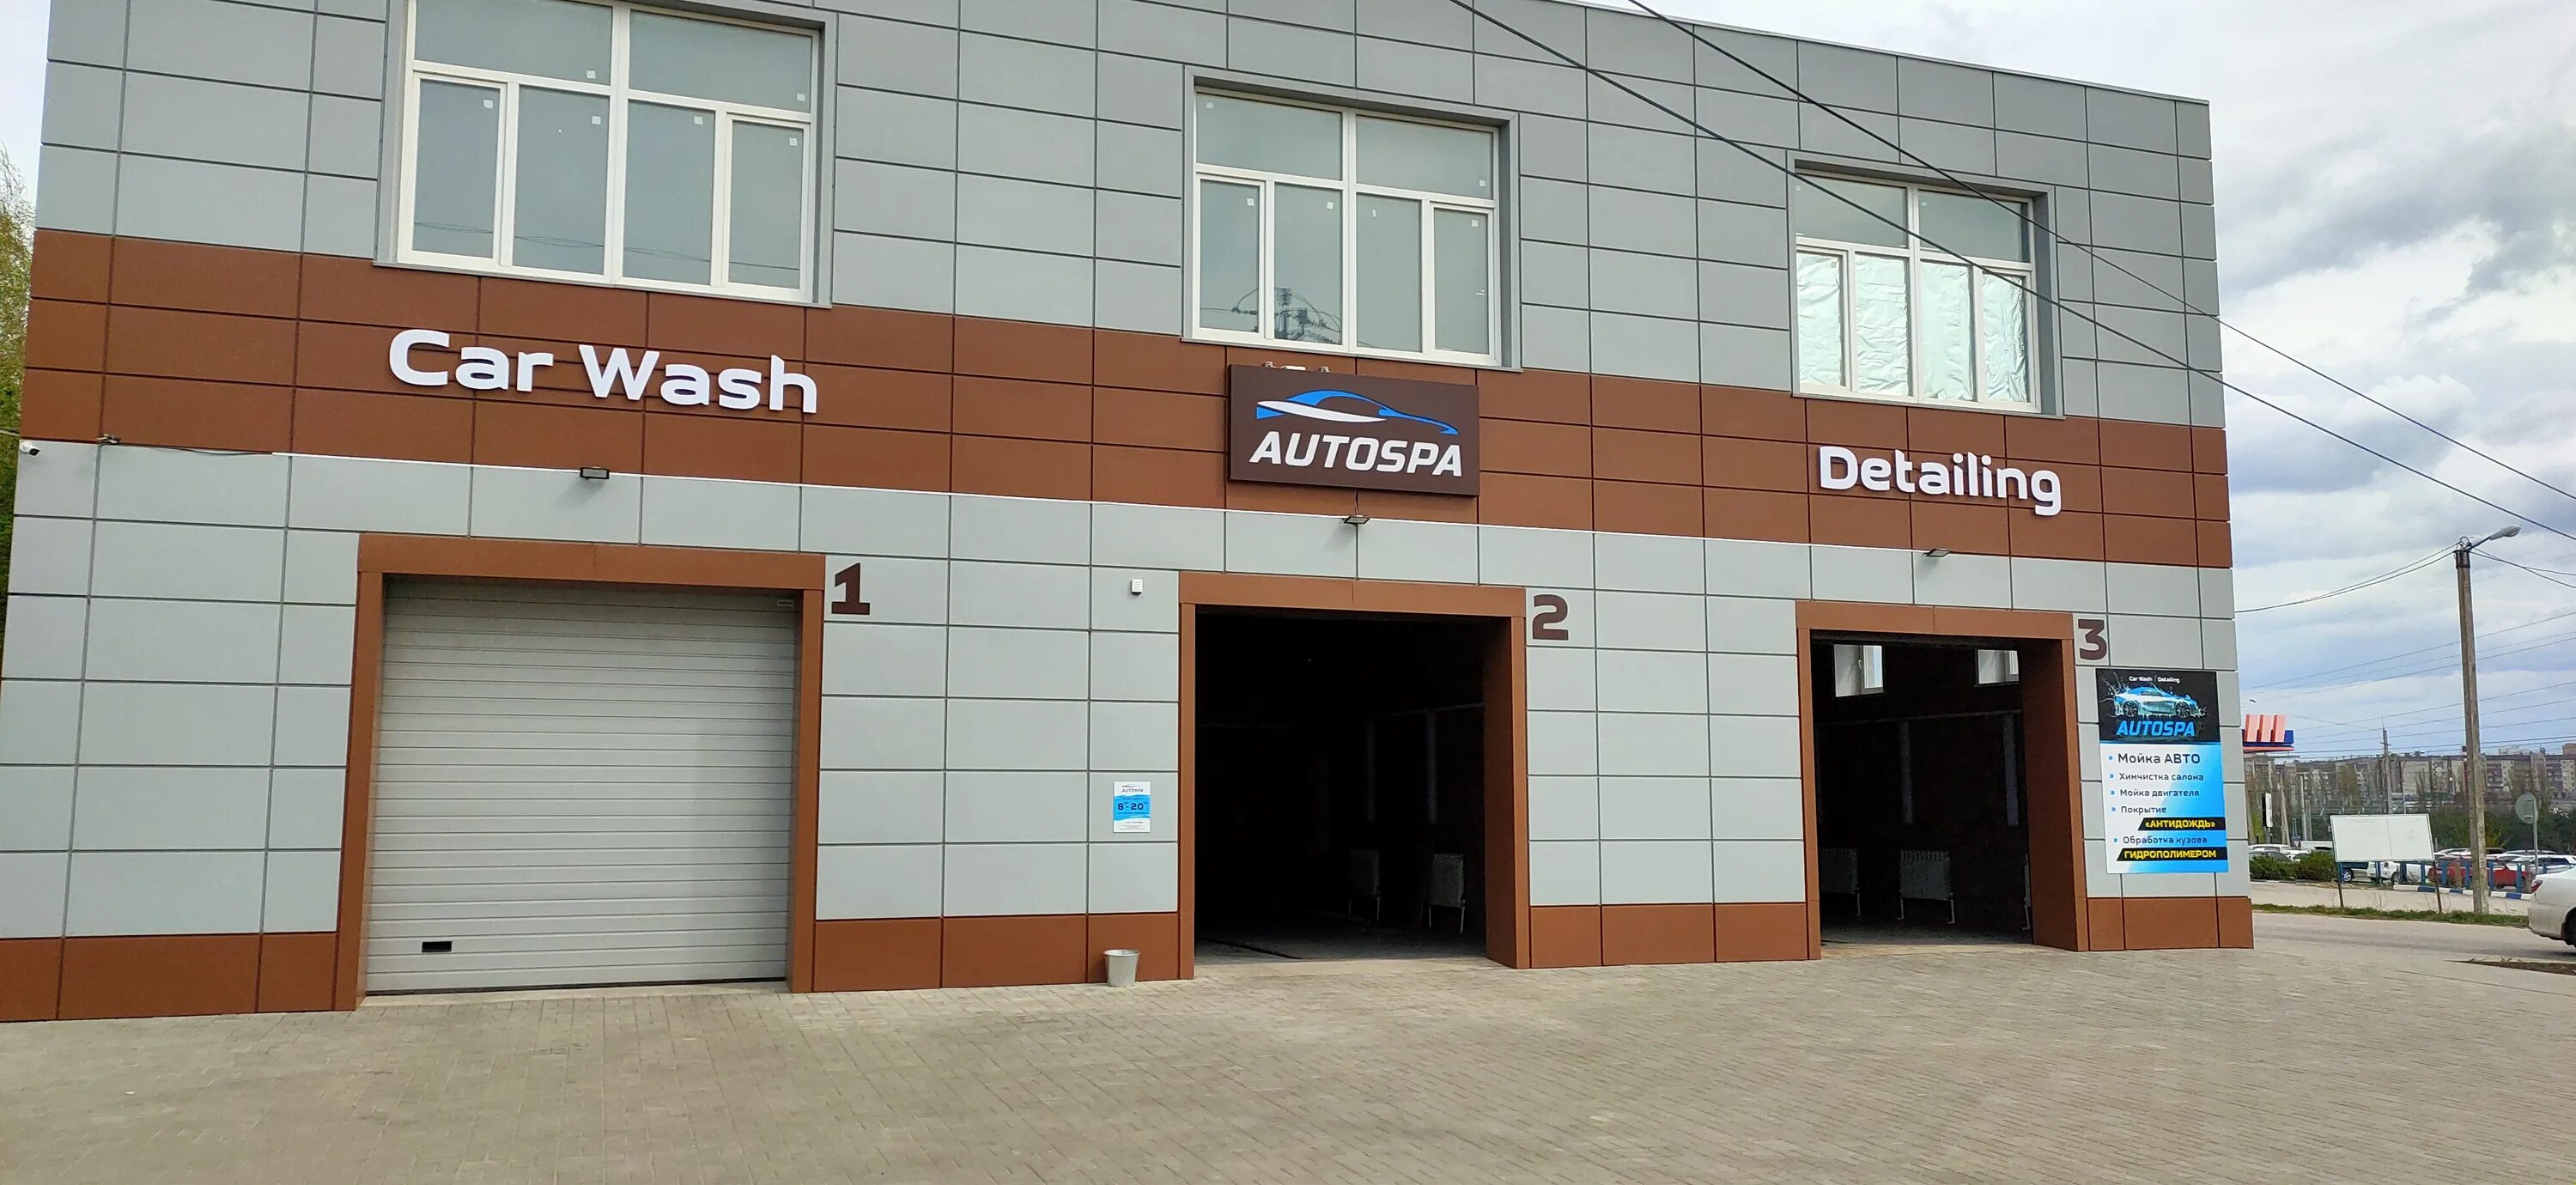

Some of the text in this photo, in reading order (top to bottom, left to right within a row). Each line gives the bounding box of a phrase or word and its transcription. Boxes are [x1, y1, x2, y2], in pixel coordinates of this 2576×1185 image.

[388, 329, 818, 415] Car Wash
[1249, 431, 1462, 477] AUTOSPA
[1819, 446, 2062, 517] Detailing
[831, 562, 871, 616] 1
[1532, 593, 1570, 641] 2
[2077, 618, 2108, 660] 3
[2116, 720, 2196, 737] AUTOSPA
[2117, 752, 2201, 764] Мойка АВТО
[2118, 772, 2169, 781] Химчистка
[2119, 788, 2150, 797] Мойка
[2121, 805, 2167, 815] Покрытие
[2123, 836, 2208, 846] Обработка кузова
[2123, 849, 2216, 860] ГИДРОПОЛИМЕРОМ
